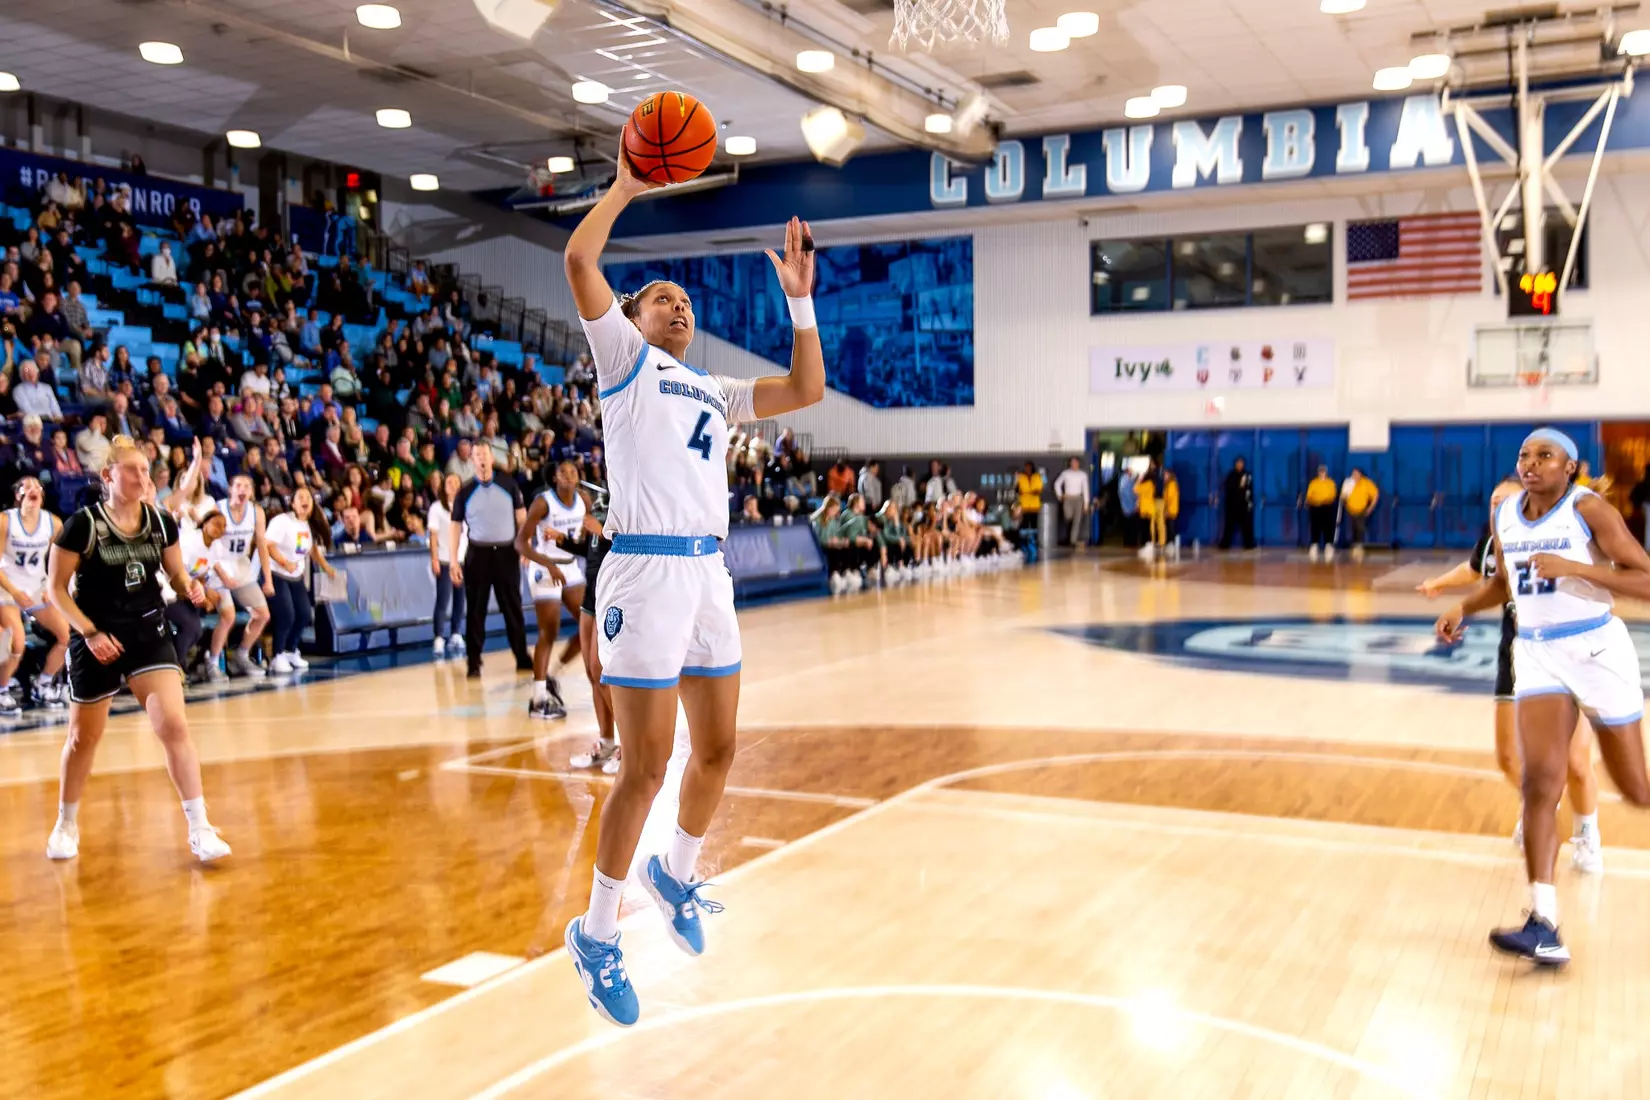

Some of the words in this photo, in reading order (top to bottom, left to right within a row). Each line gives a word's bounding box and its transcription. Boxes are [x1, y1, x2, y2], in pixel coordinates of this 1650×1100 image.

[930, 94, 1454, 208] COLUMBIA
[1114, 356, 1151, 383] Ivy
[687, 410, 712, 461] 4
[229, 538, 246, 554] 12
[693, 539, 702, 555] C
[15, 551, 39, 567] 34
